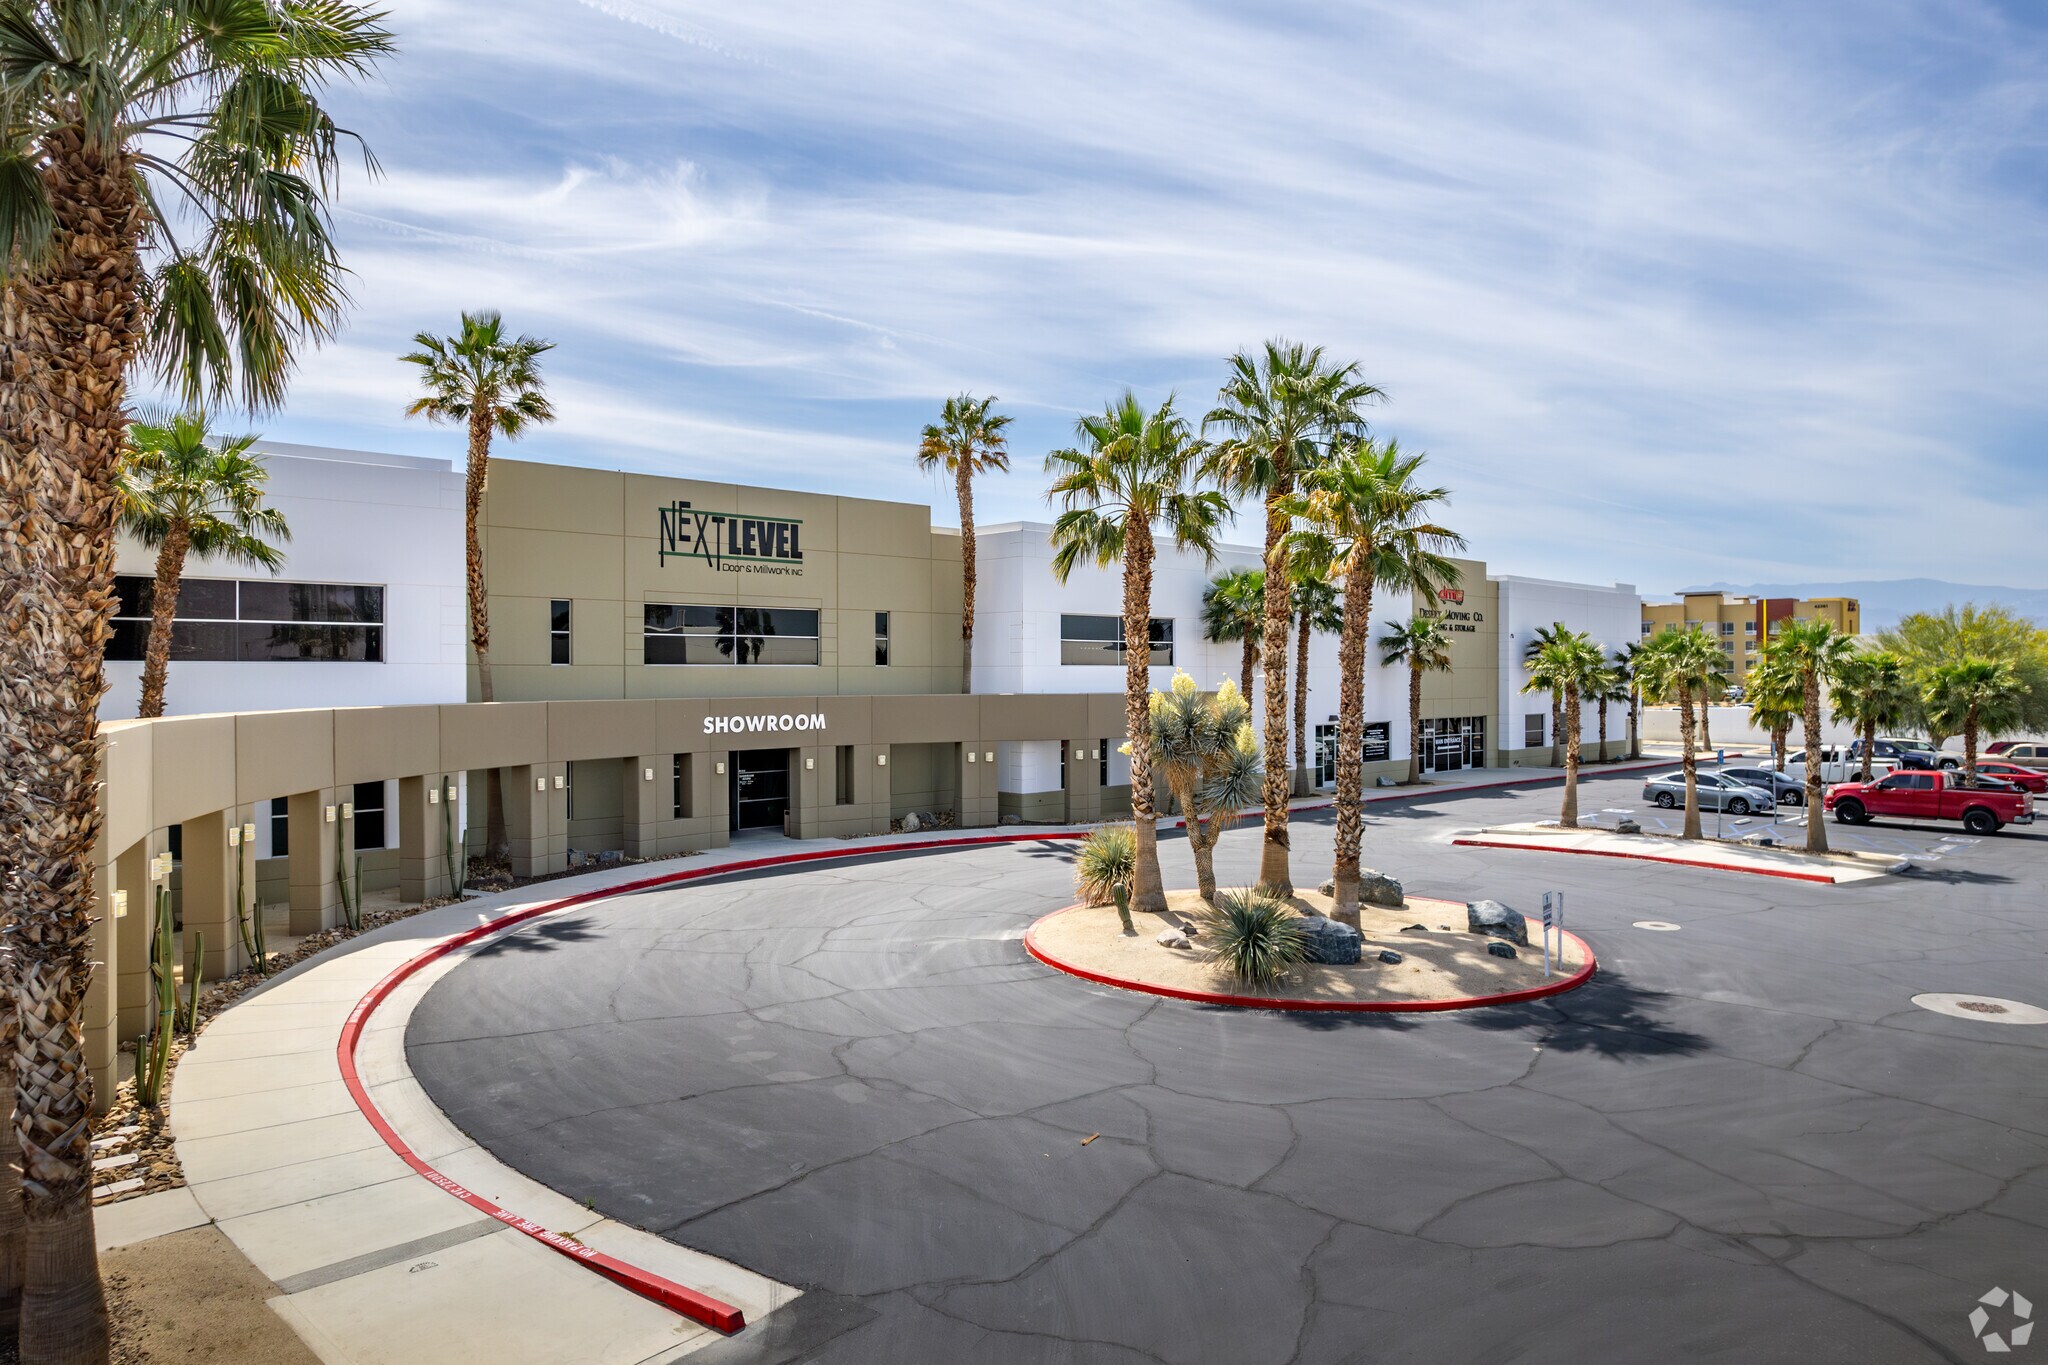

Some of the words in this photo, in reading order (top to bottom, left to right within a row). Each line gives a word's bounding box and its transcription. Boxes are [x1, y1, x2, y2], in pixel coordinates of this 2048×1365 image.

[660, 500, 726, 571] NEXT
[728, 518, 803, 559] LEVEL
[722, 563, 745, 573] Door
[746, 564, 752, 573] &
[753, 564, 790, 576] Millwork
[791, 568, 803, 577] INC
[1449, 624, 1453, 632] &
[1455, 624, 1476, 632] STORAGE
[703, 713, 826, 734] SHOWROOM
[451, 1187, 472, 1199] CVC
[492, 1209, 521, 1223] LANE
[516, 1220, 542, 1233] FIRE
[540, 1230, 583, 1251] PARKING
[579, 1248, 598, 1258] NO
